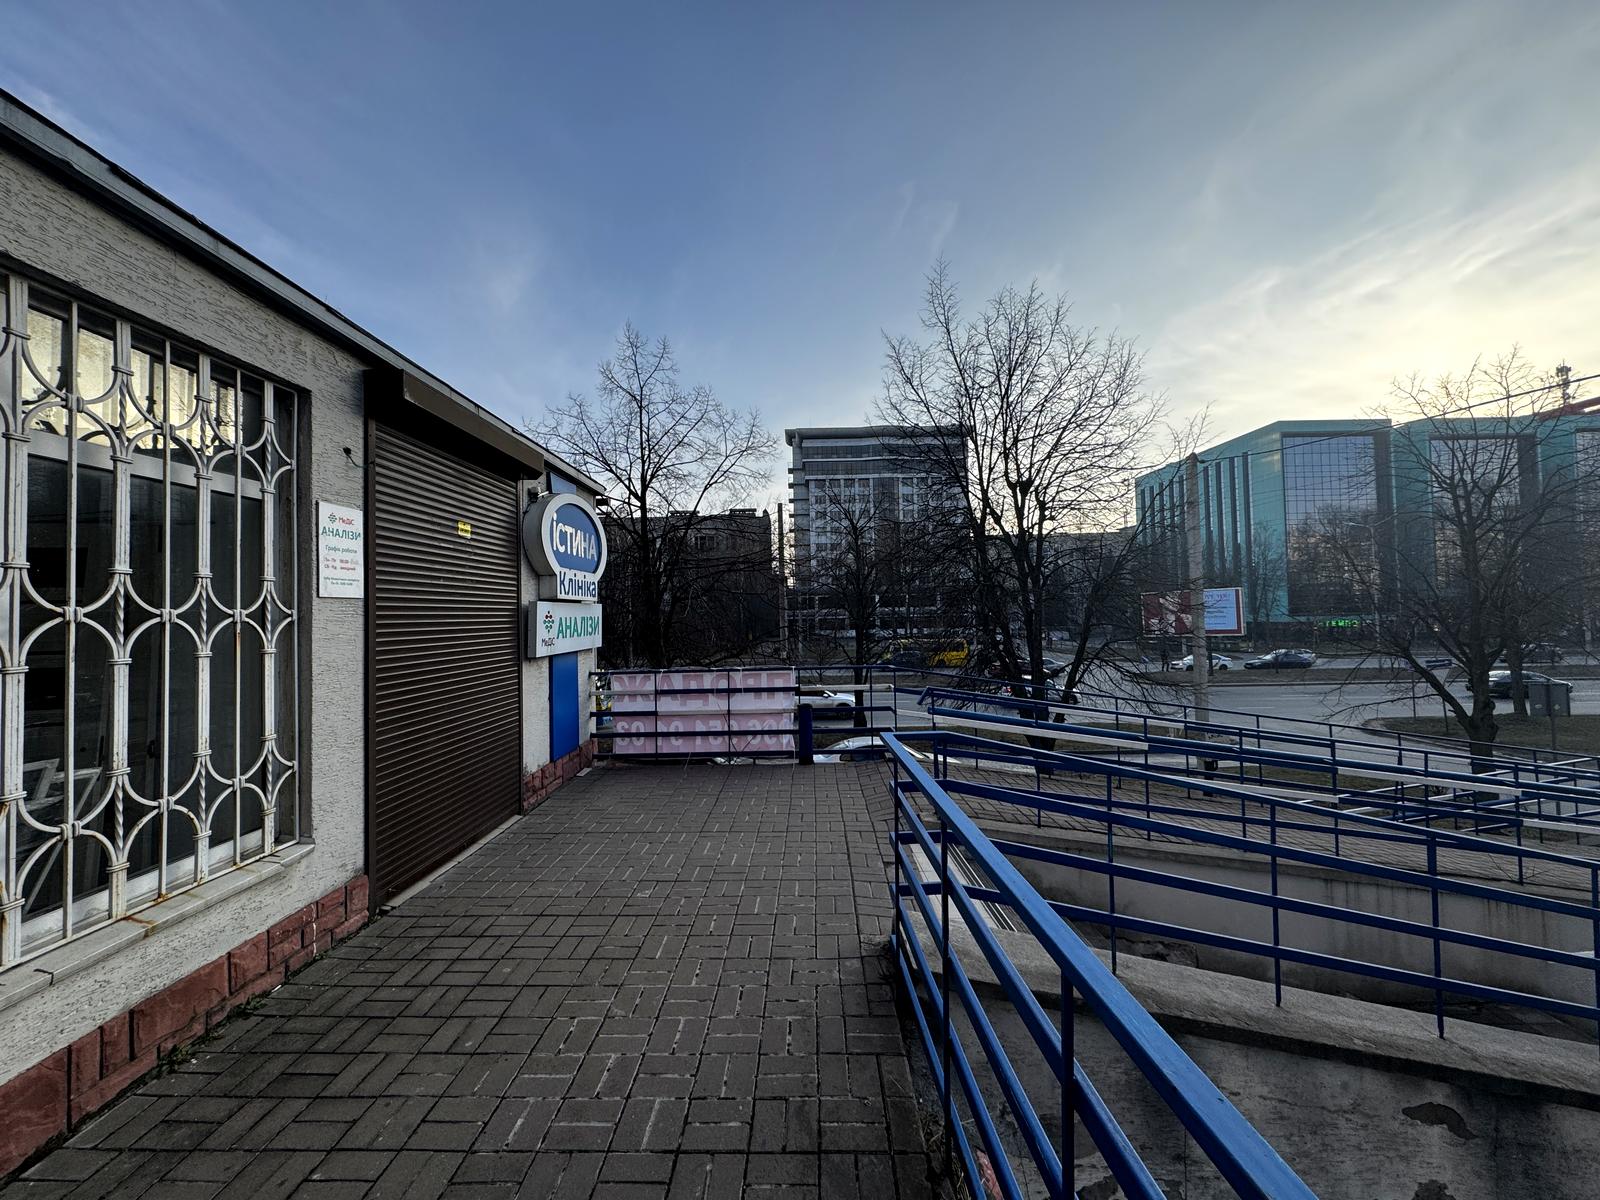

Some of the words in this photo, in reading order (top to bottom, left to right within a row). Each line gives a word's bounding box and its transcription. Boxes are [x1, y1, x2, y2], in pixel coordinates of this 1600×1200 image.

[321, 526, 361, 541] АНАЛІЗИ
[559, 571, 597, 598] Клініка
[556, 616, 600, 640] АНАЛІЗИ
